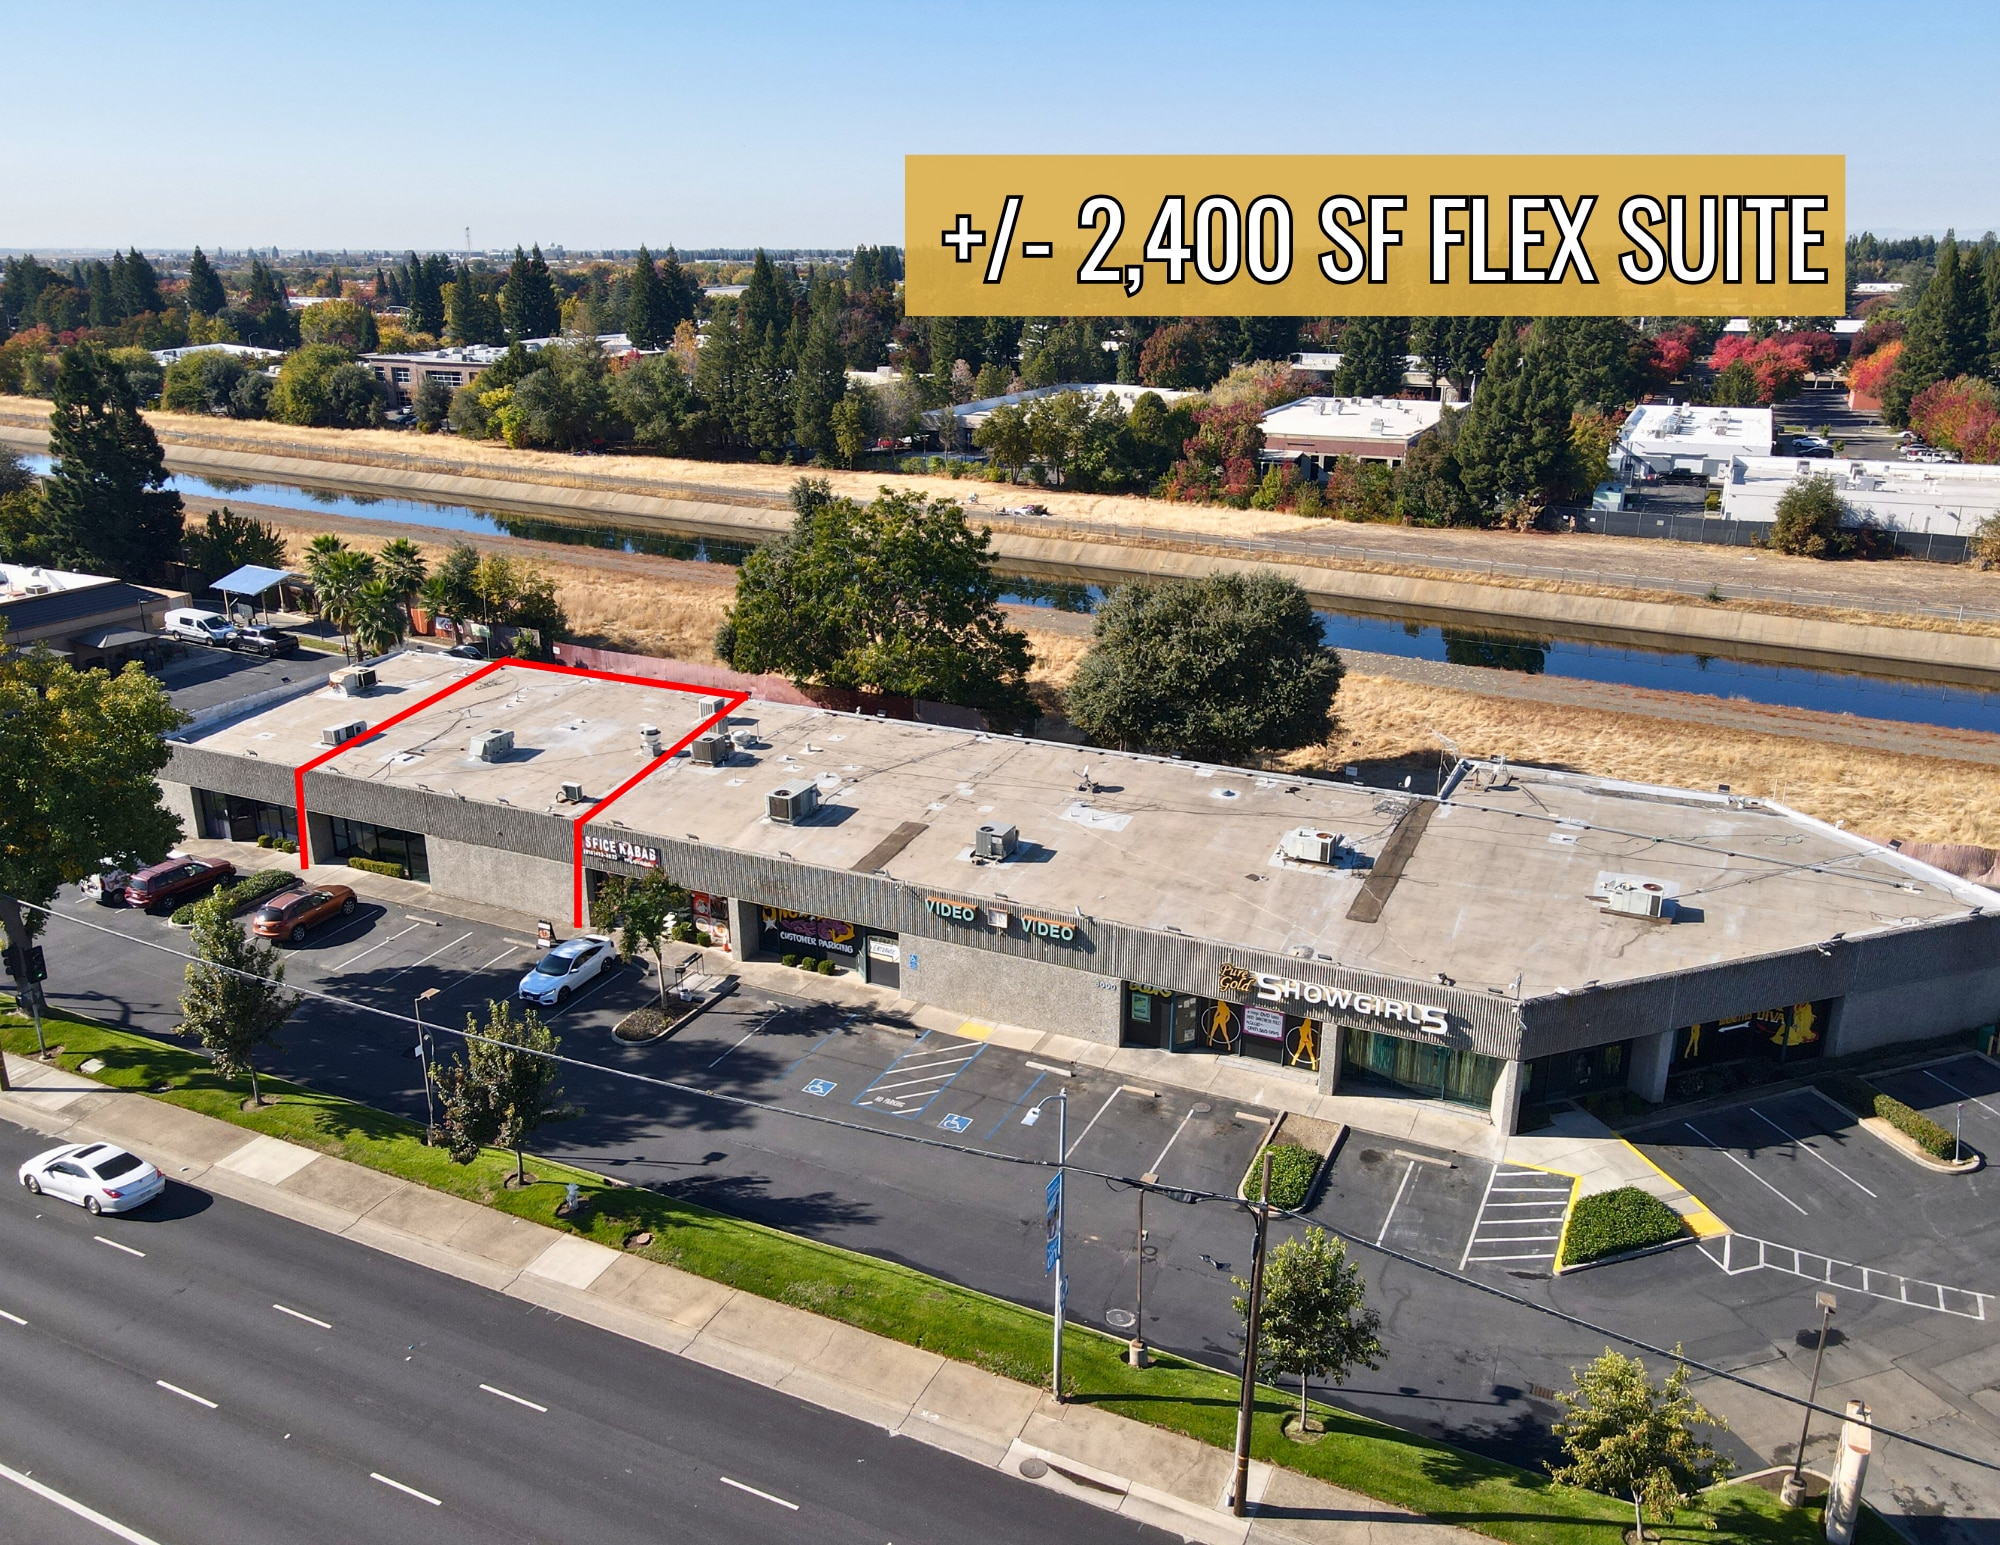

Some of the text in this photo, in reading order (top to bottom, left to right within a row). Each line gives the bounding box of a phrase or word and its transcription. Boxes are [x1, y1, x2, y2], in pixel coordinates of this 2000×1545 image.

[925, 898, 975, 922] VIDEO
[1021, 917, 1074, 941] VIDEO
[780, 931, 817, 946] CUSTOMER
[818, 939, 854, 954] PARKING
[1219, 963, 1250, 979] Pure
[1219, 977, 1255, 992] Gold
[1257, 974, 1449, 1036] SHOWGIRLS
